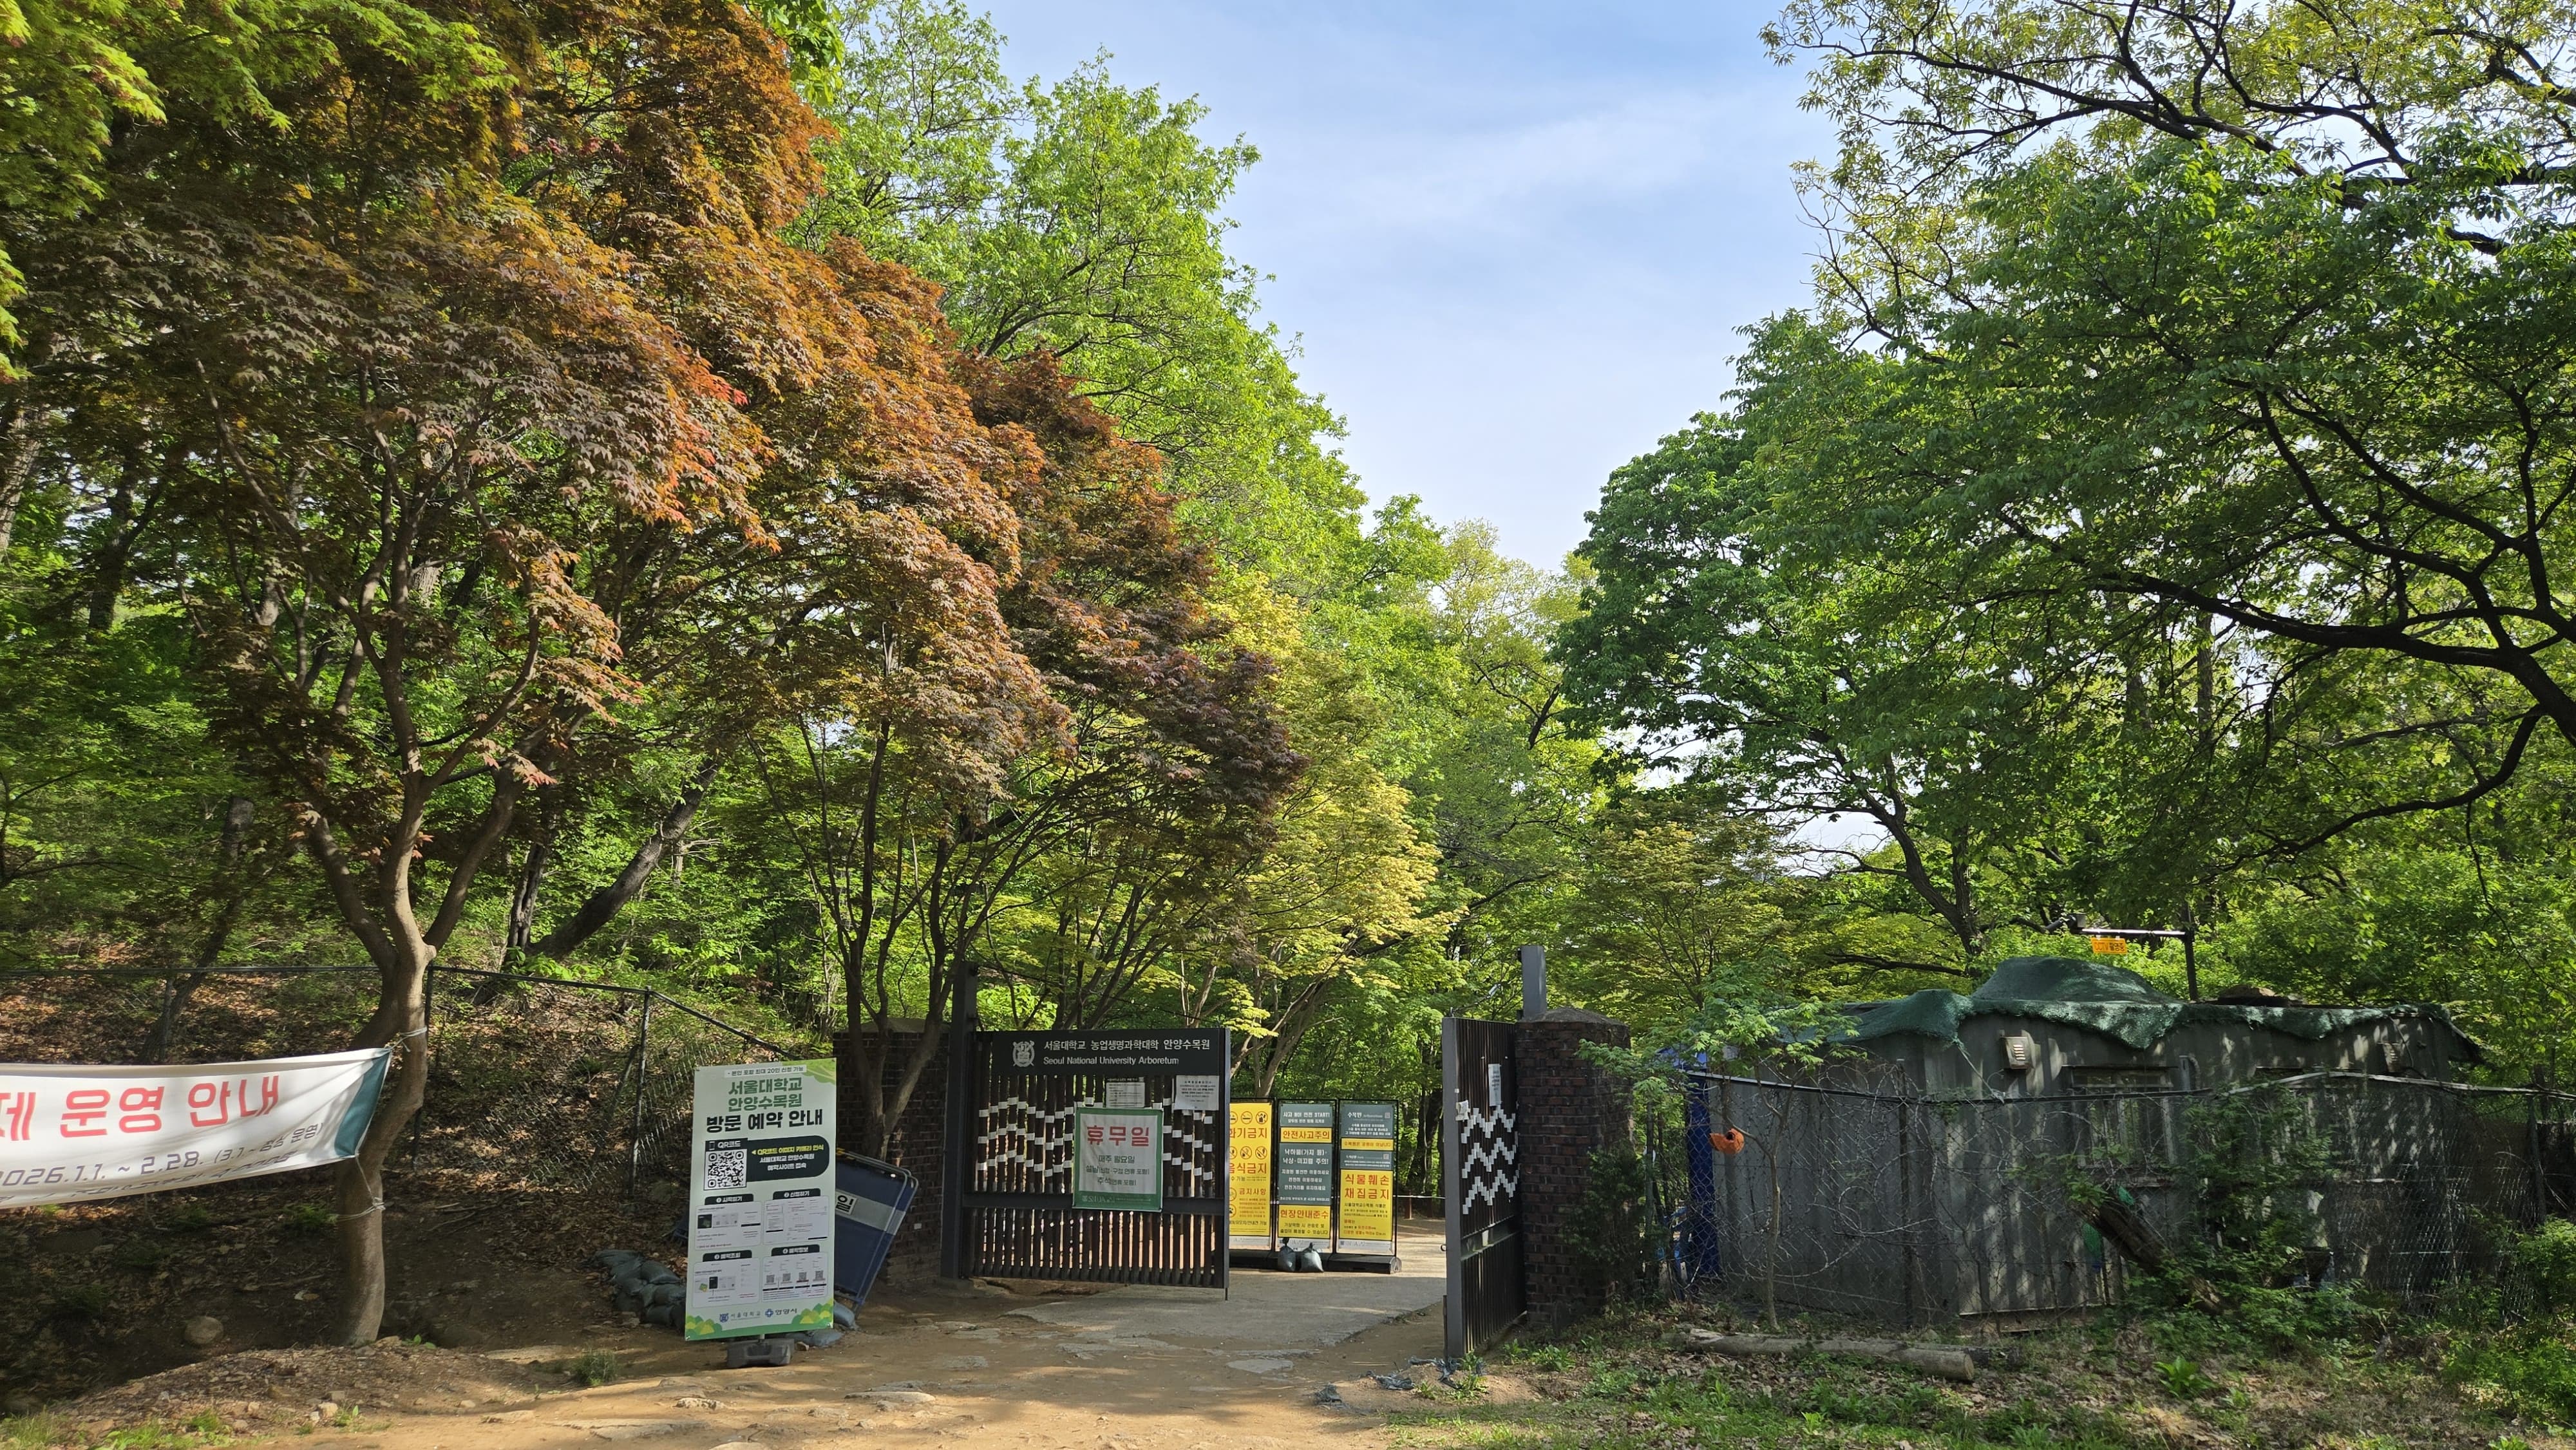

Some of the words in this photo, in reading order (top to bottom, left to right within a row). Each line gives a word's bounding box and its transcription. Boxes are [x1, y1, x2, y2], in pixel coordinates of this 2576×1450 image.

[1044, 1040, 1086, 1050] 서울대학교
[1091, 1040, 1159, 1050] 농업생명과학대학
[1163, 1039, 1210, 1050] 안양수목원
[1099, 1056, 1136, 1066] University
[728, 1077, 802, 1095] 서울대학교
[60, 1086, 165, 1138] 운영
[188, 1075, 279, 1127] 안내
[728, 1093, 802, 1112] 안양수목원
[706, 1115, 741, 1133] 방문
[748, 1112, 783, 1130] 예약
[789, 1109, 822, 1127] 안내
[290, 1123, 323, 1144] 운영)
[1087, 1125, 1149, 1147] 휴무일
[1283, 1131, 1330, 1139] 안전사고주의
[717, 1140, 741, 1149] QR코드
[0, 1163, 106, 1186] 026.1.1.
[140, 1151, 203, 1175] 2.28.
[1345, 1188, 1389, 1200] 채집금지
[835, 1195, 854, 1212] 일
[1280, 1210, 1329, 1219] 현장안내준수
